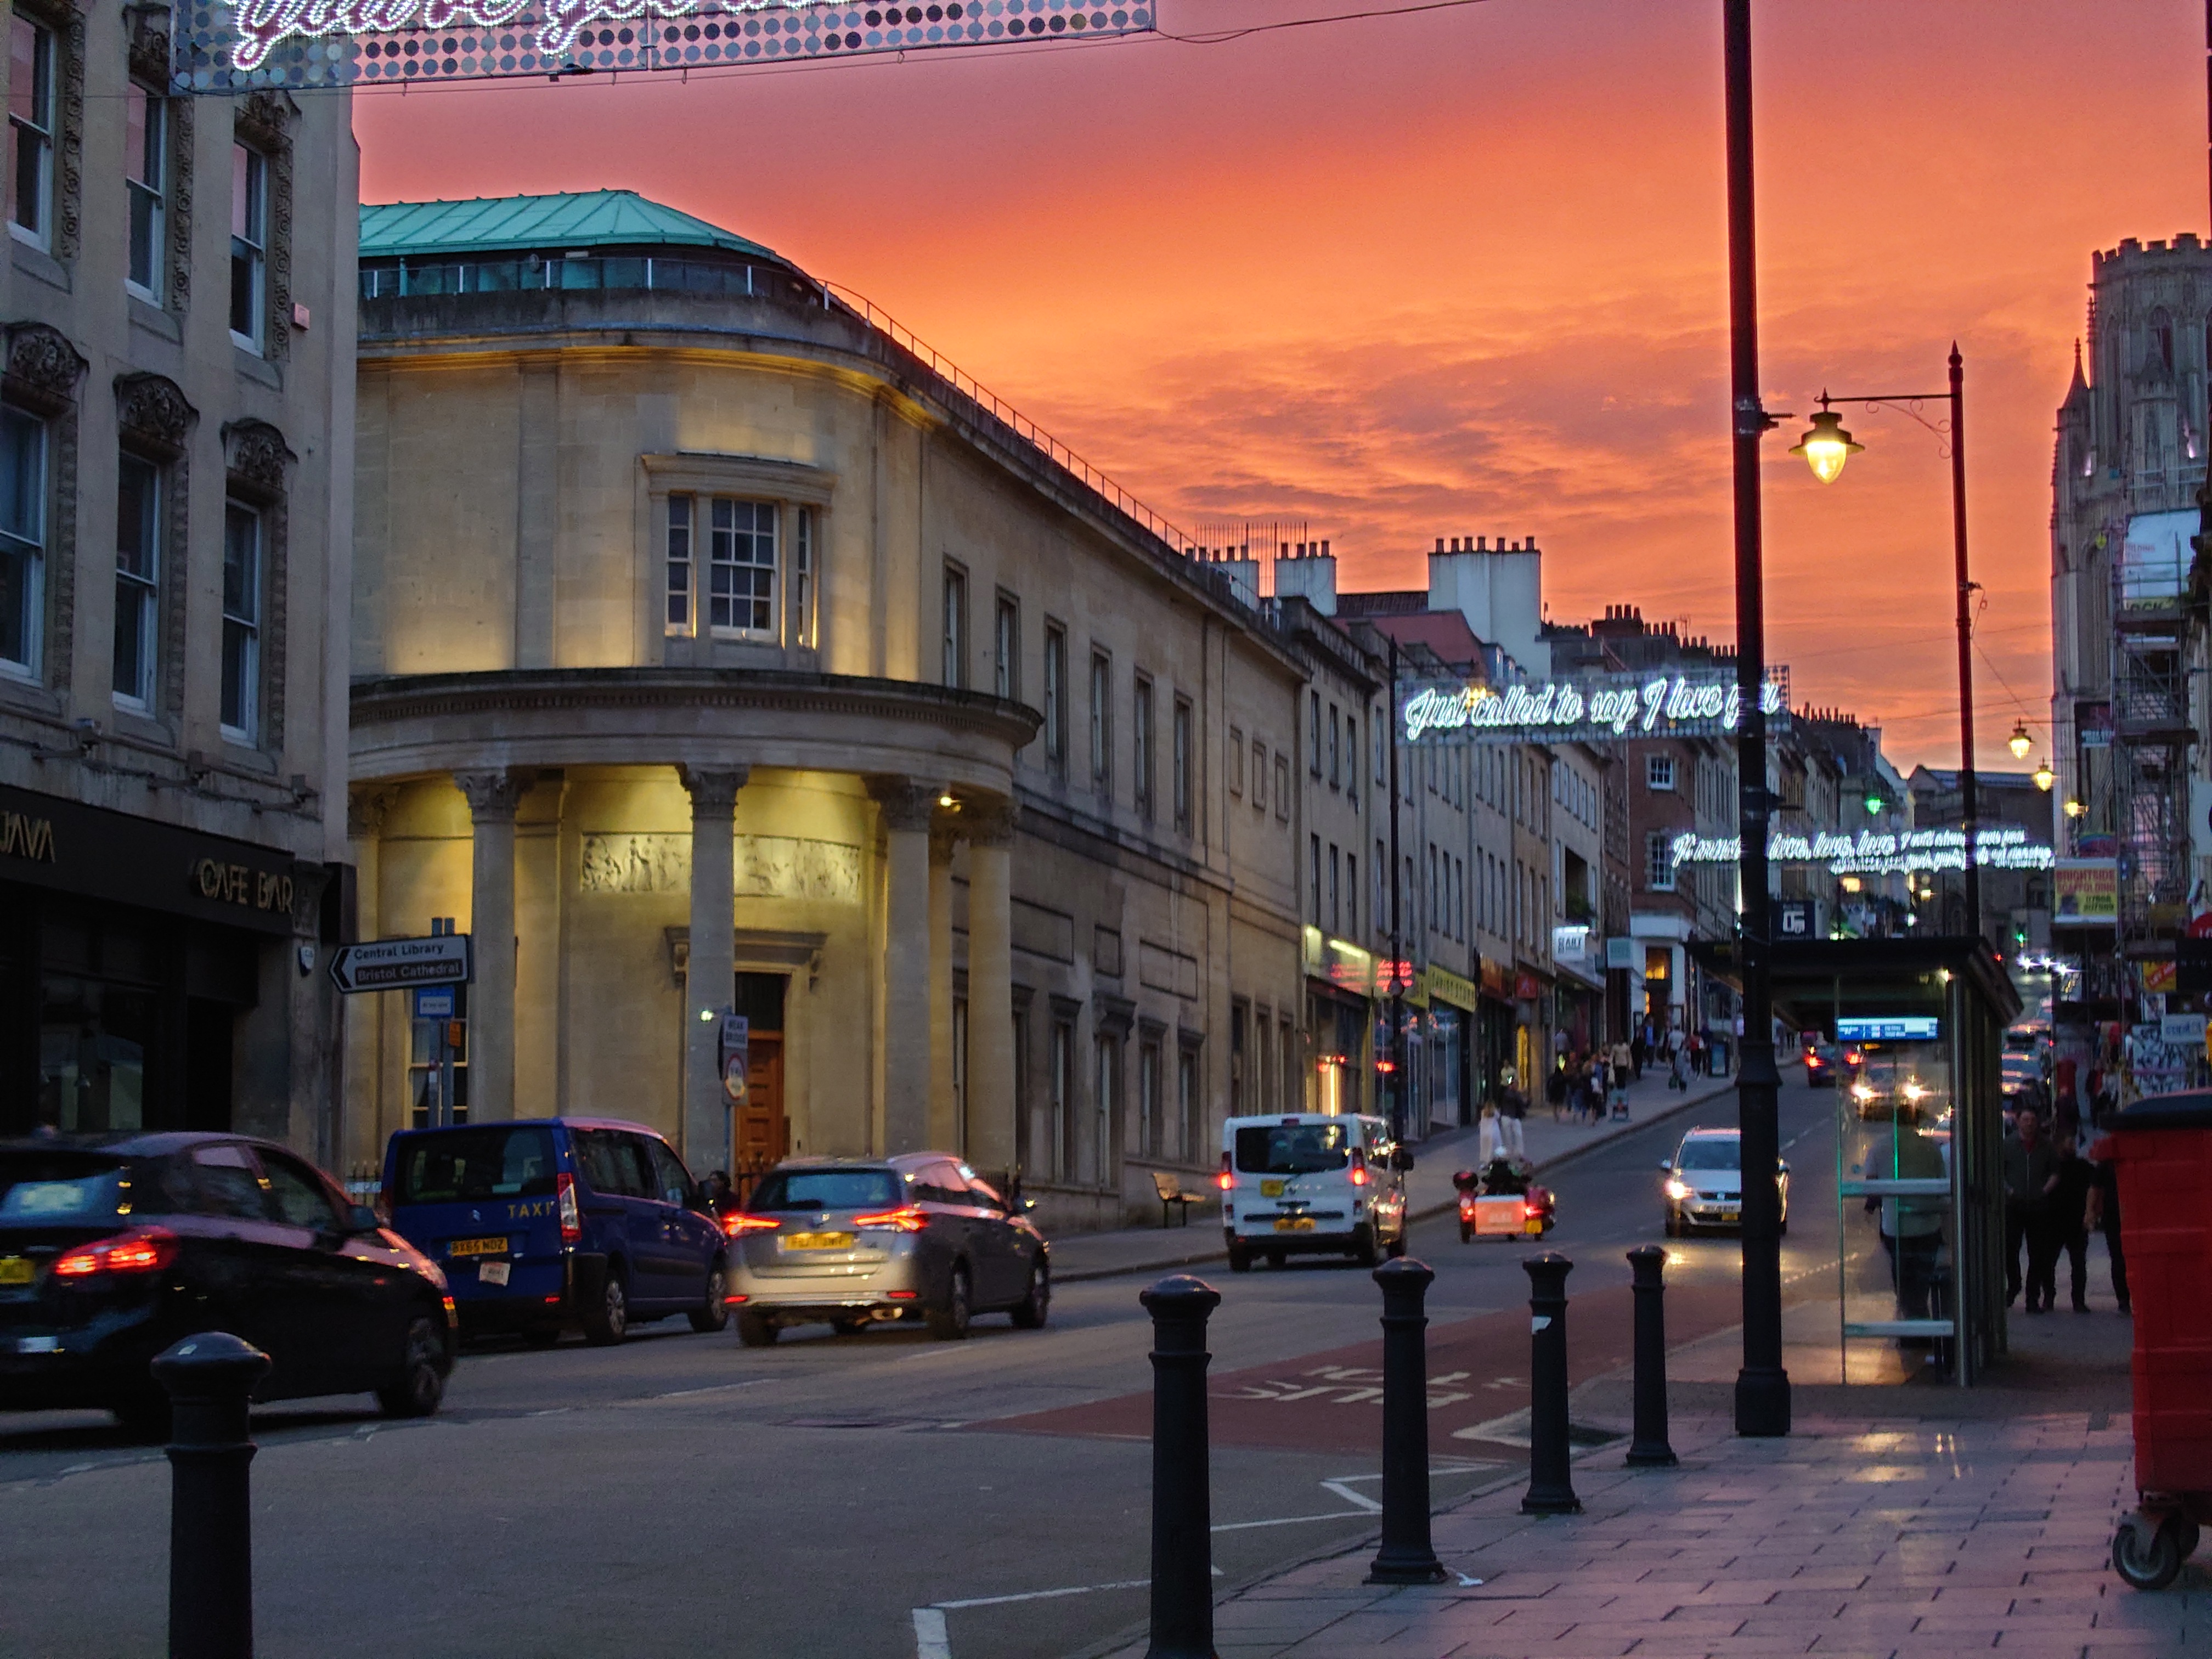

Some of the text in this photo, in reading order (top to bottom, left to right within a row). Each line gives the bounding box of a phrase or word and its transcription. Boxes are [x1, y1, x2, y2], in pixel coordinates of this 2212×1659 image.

[1405, 676, 1779, 741] Just called to say I love yu
[0, 811, 56, 863] JAVA
[257, 871, 294, 915] BAR
[354, 944, 444, 960] Central Library
[357, 962, 460, 981] Bristol Cathedral
[508, 1202, 552, 1218] TAXI
